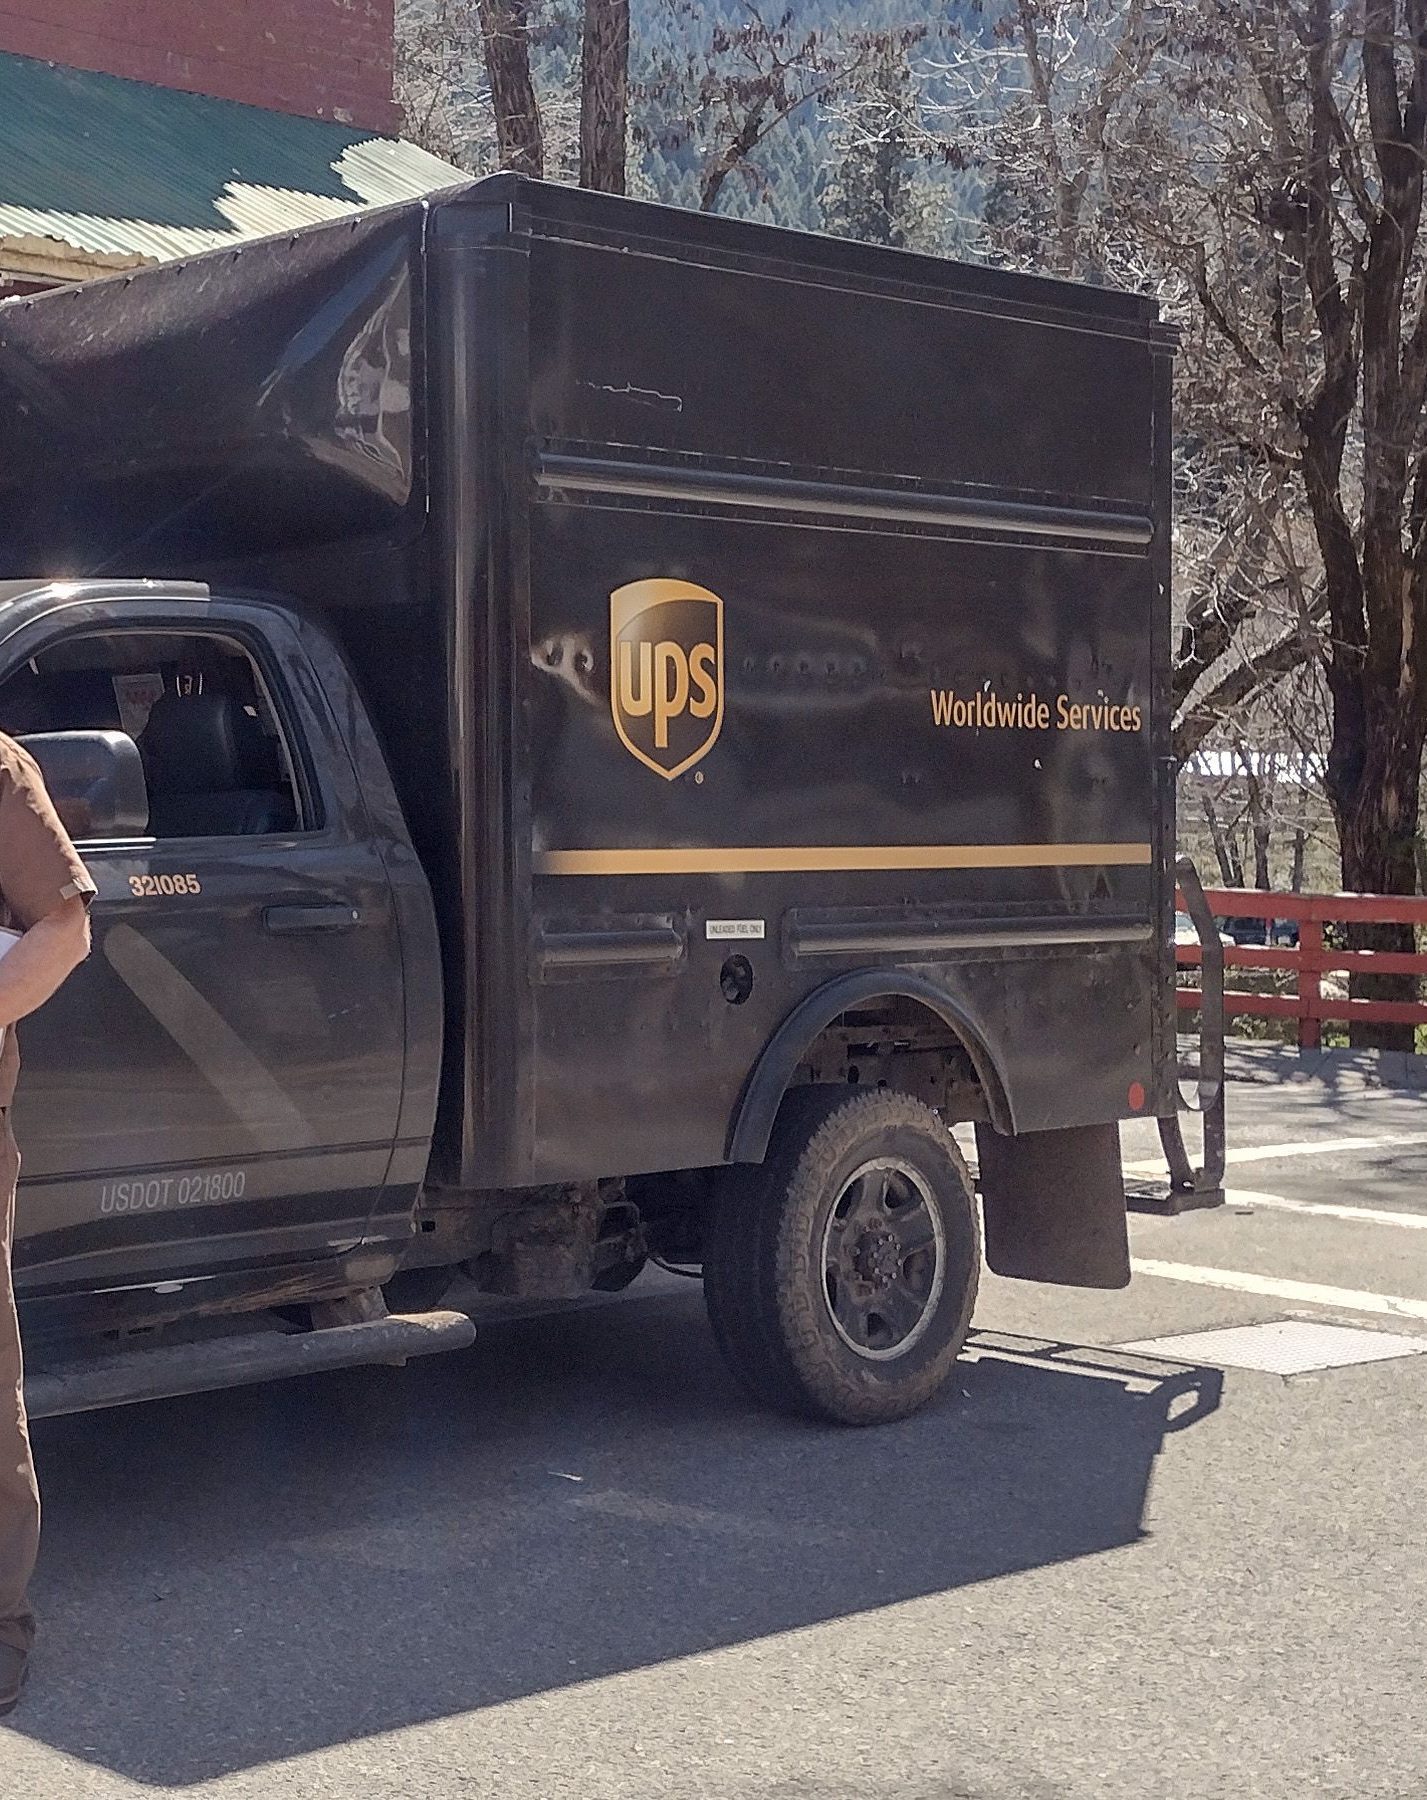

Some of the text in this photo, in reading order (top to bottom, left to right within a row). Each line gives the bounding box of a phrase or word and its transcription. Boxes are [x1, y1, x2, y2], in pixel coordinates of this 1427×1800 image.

[620, 640, 717, 748] ups
[930, 689, 1142, 732] Worldwide Services
[128, 874, 201, 897] 321085
[100, 1171, 246, 1213] USDOT 021800
